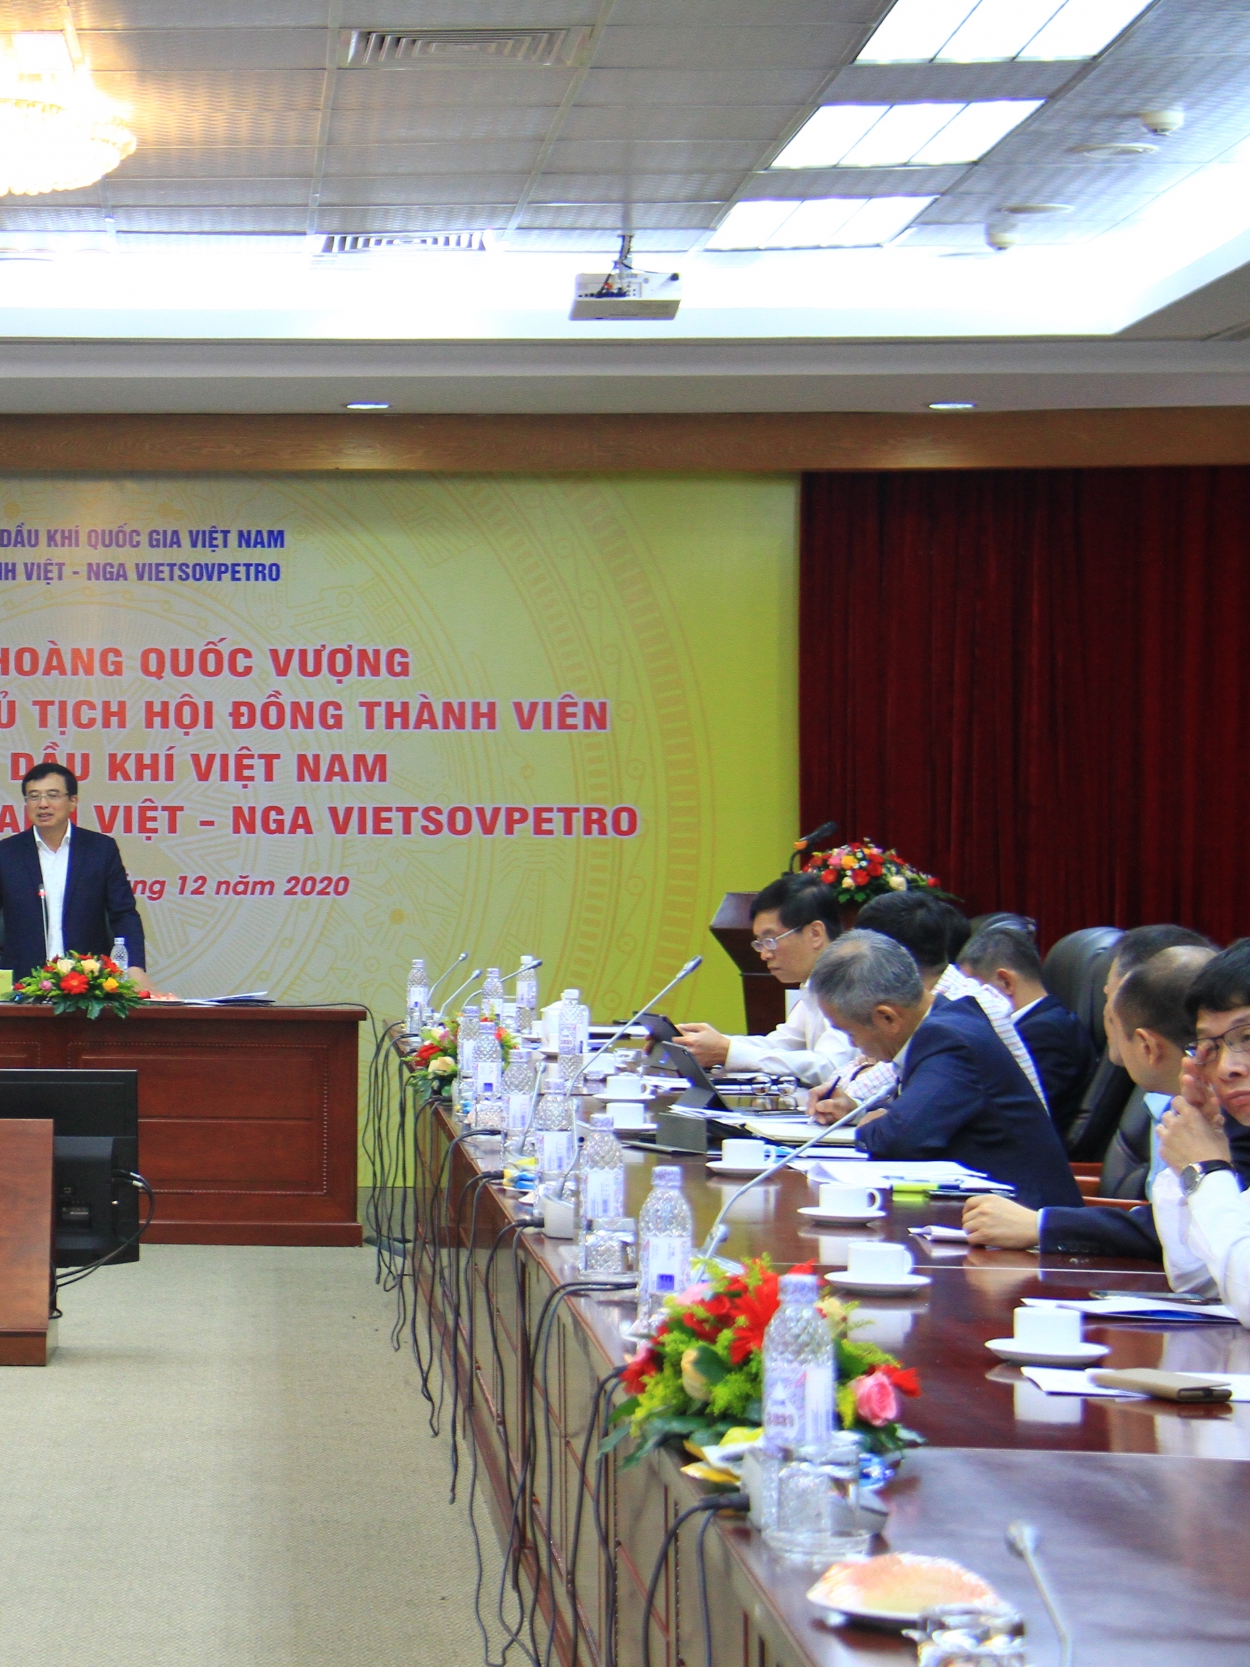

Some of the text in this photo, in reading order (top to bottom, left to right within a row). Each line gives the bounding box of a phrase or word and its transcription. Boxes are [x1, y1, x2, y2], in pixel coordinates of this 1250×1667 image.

[0, 523, 39, 548] DẦU
[46, 525, 80, 548] KHÍ
[87, 523, 141, 549] QUỐC
[148, 529, 182, 548] GIA
[189, 526, 231, 552] VIỆT
[238, 529, 285, 548] NAM
[24, 558, 66, 585] VIỆT
[87, 562, 128, 581] NGA
[135, 562, 281, 582] VIETSOVPETRO
[140, 638, 253, 681] QUỐC
[269, 645, 410, 684] VƯỢNG
[33, 699, 126, 735] TỊCH
[144, 694, 213, 736] HỘI
[230, 690, 343, 730] ĐỒNG
[359, 694, 497, 730] THÀNH
[513, 695, 608, 730] VIÊN
[108, 746, 175, 781] KHÍ
[190, 746, 281, 788] VIỆT
[296, 753, 388, 782] NAM
[94, 798, 184, 840] VIỆT
[232, 805, 314, 834] NGA
[329, 806, 638, 836] VIETSOVPETRO
[179, 875, 208, 895] 12
[216, 876, 275, 896] năm
[284, 876, 349, 896] 2020
